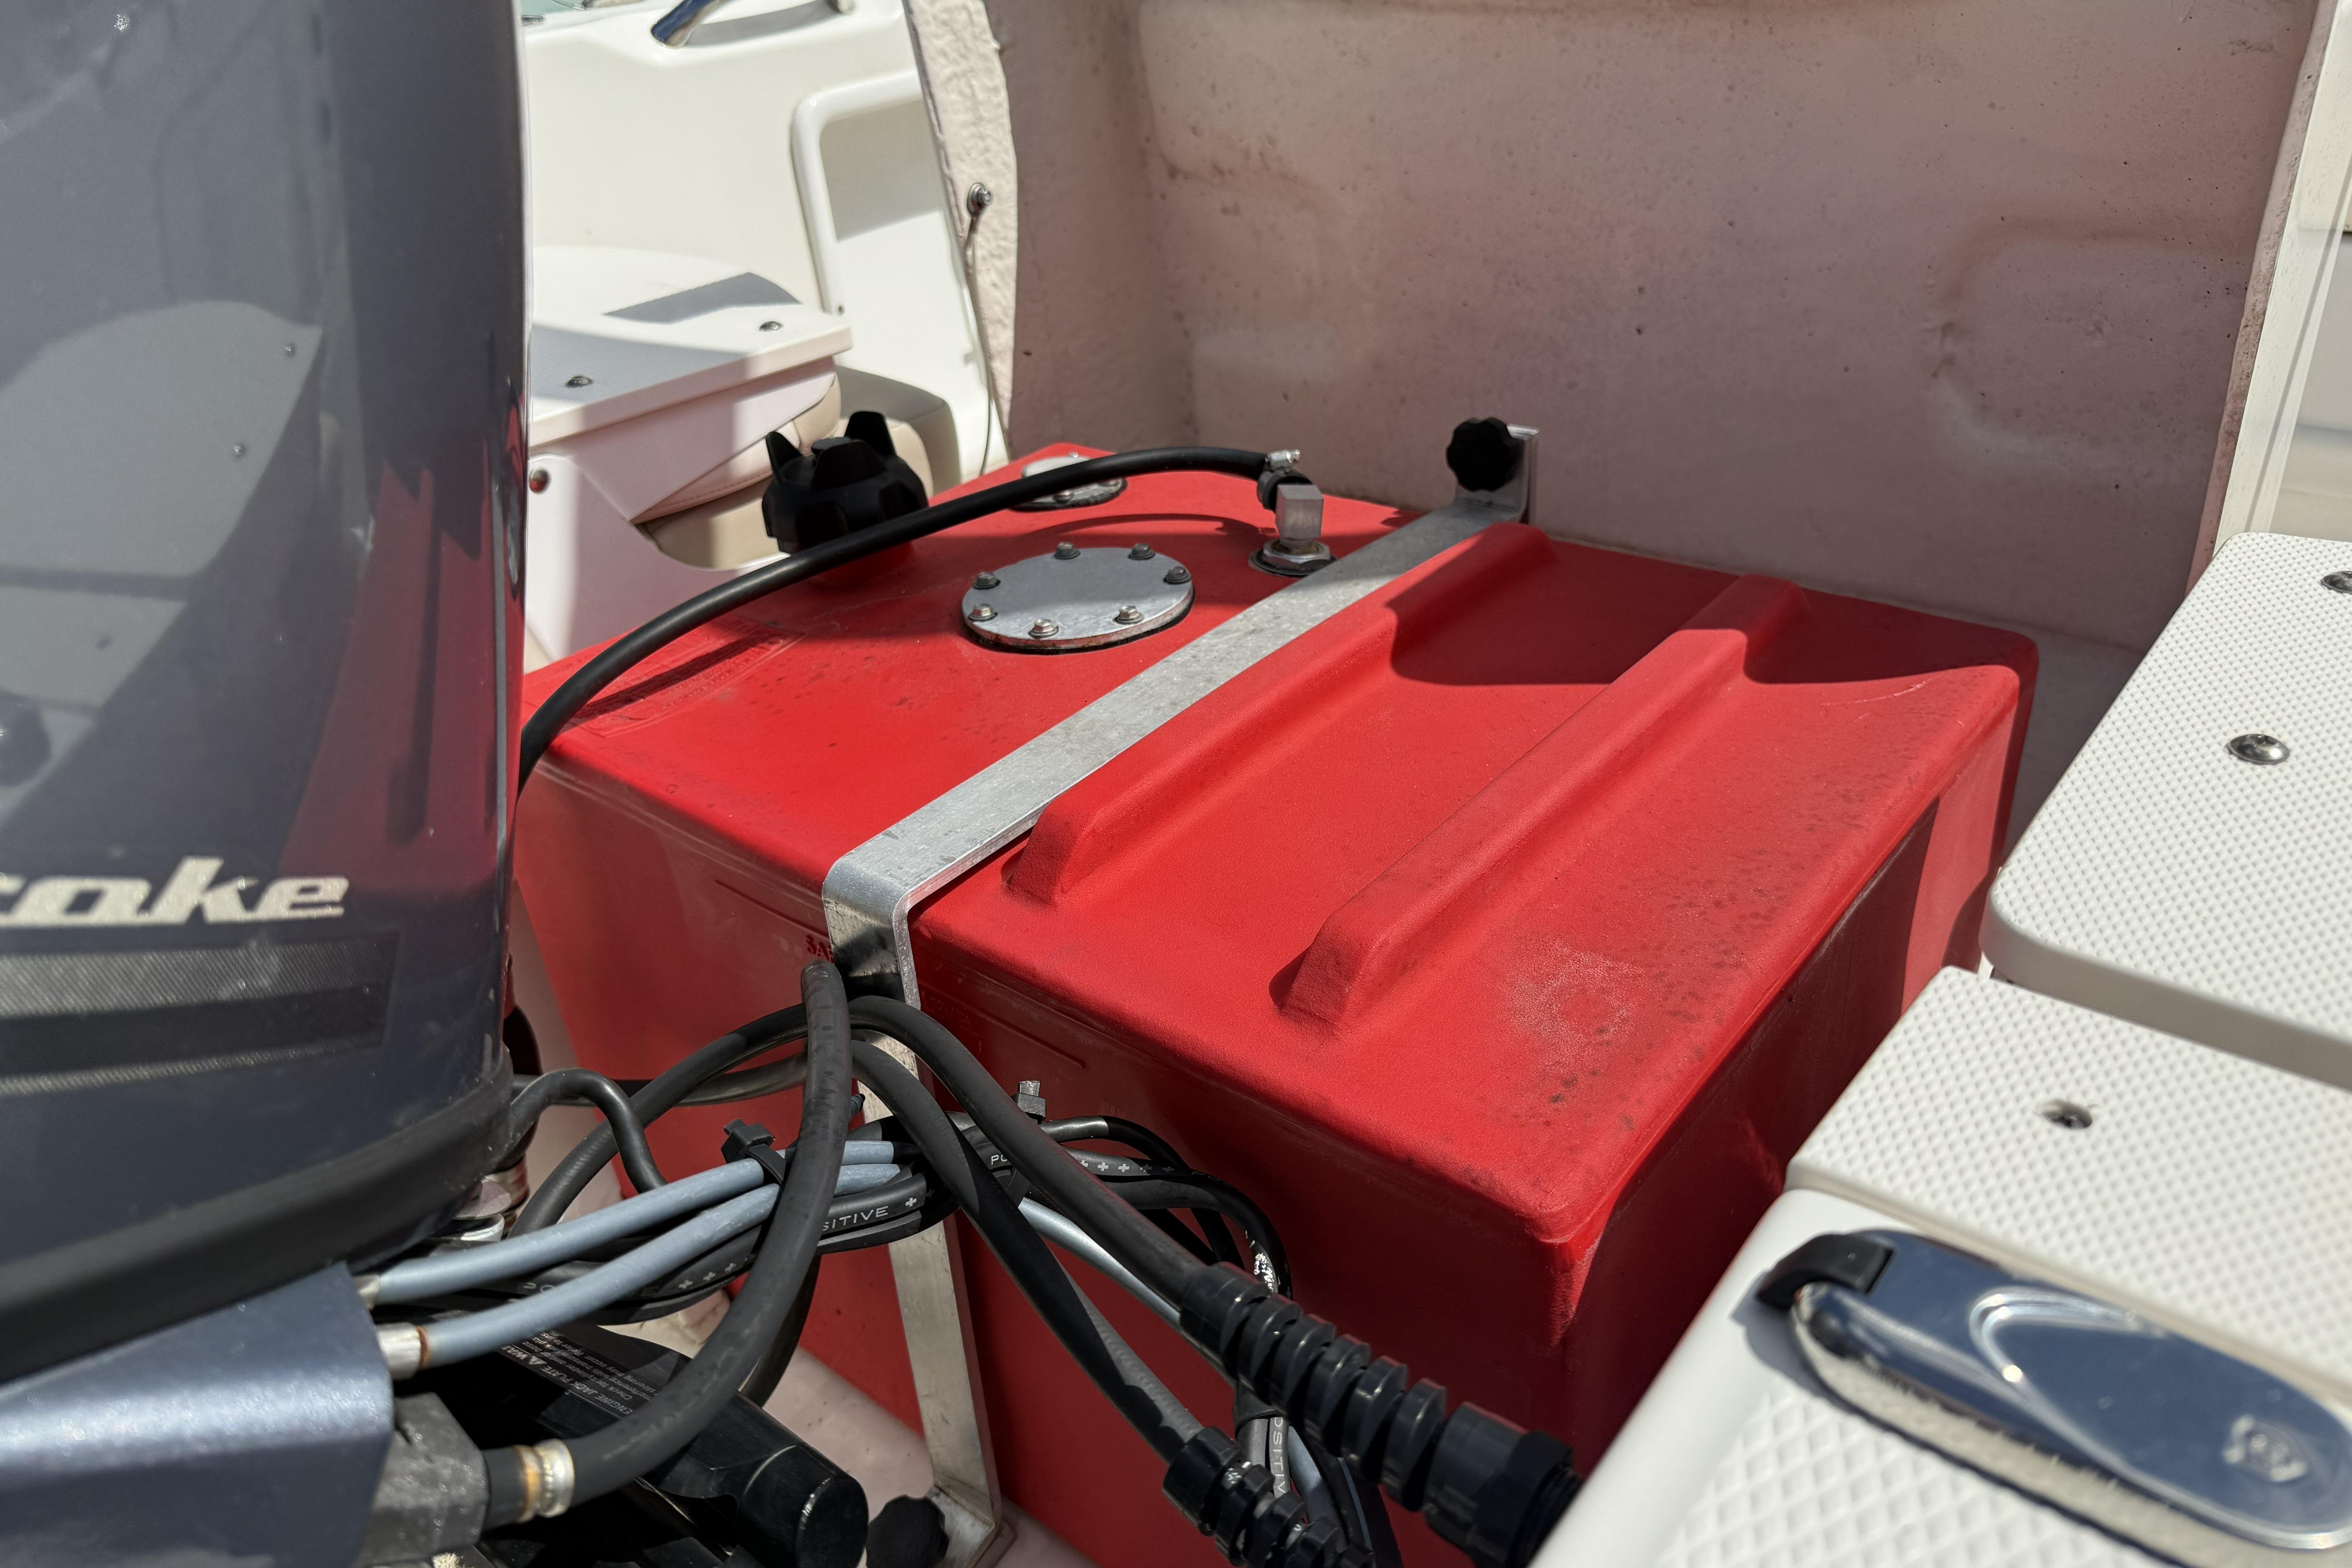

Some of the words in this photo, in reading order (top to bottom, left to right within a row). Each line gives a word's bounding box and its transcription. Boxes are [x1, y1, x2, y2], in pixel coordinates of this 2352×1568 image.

[541, 1365, 574, 1384] PLATE
[592, 1368, 610, 1378] with
[606, 1367, 625, 1377] may
[569, 1381, 598, 1395] JACK
[594, 1379, 609, 1388] for
[609, 1377, 651, 1400] nterference
[607, 1386, 633, 1400] Check
[594, 1393, 633, 1415] ENGINE
[1273, 1416, 1286, 1494] OSITIV
